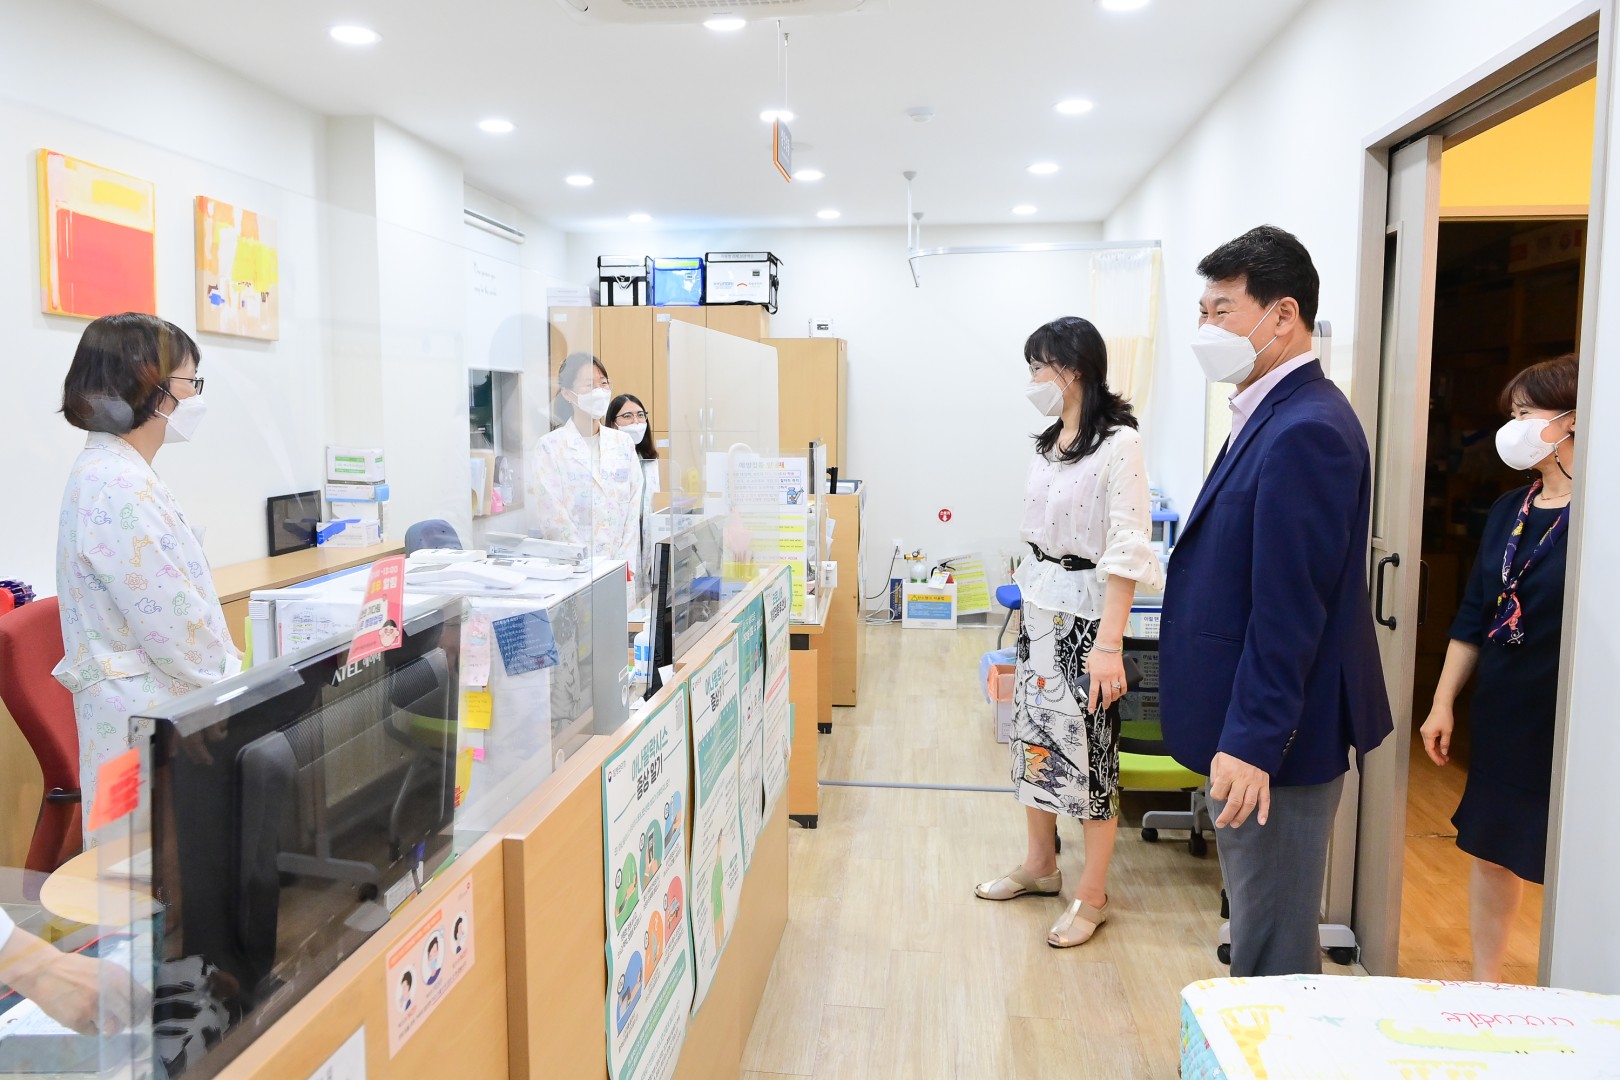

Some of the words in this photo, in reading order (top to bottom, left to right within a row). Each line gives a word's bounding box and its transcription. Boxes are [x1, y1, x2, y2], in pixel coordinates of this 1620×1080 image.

[632, 725, 668, 781] 아나필락시스
[637, 767, 650, 801] 증상
[650, 752, 663, 784] 알기
